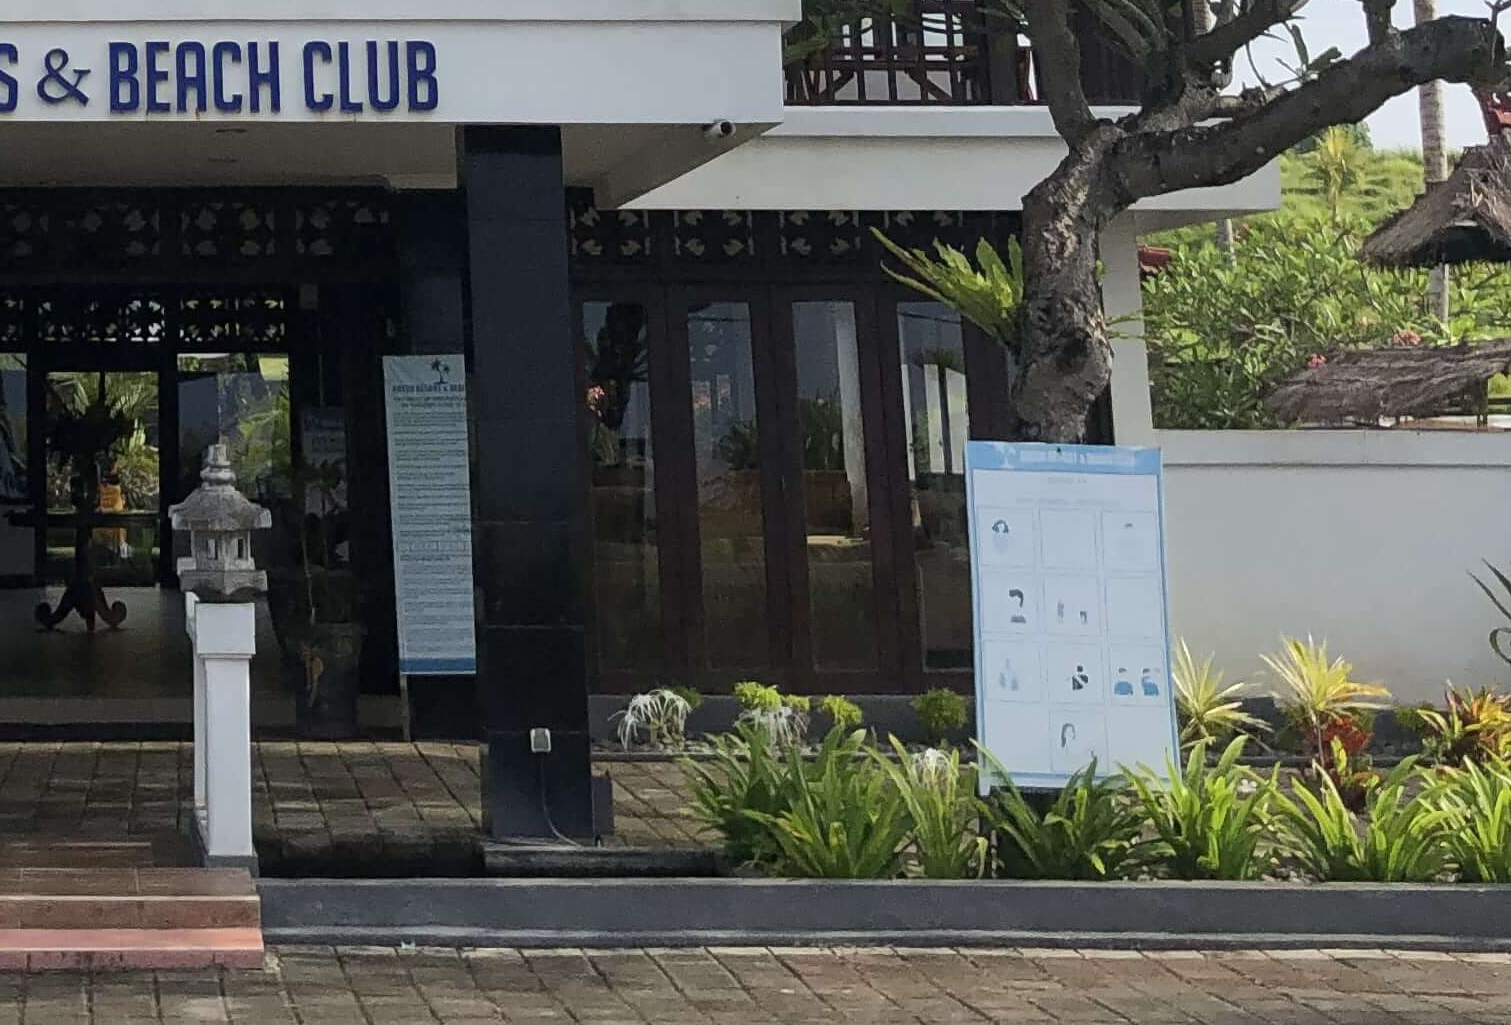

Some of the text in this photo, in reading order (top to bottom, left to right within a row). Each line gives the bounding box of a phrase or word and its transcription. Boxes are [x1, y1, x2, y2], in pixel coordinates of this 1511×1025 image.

[38, 49, 90, 105] &
[109, 41, 280, 115] BEACH
[304, 41, 438, 113] CLUB
